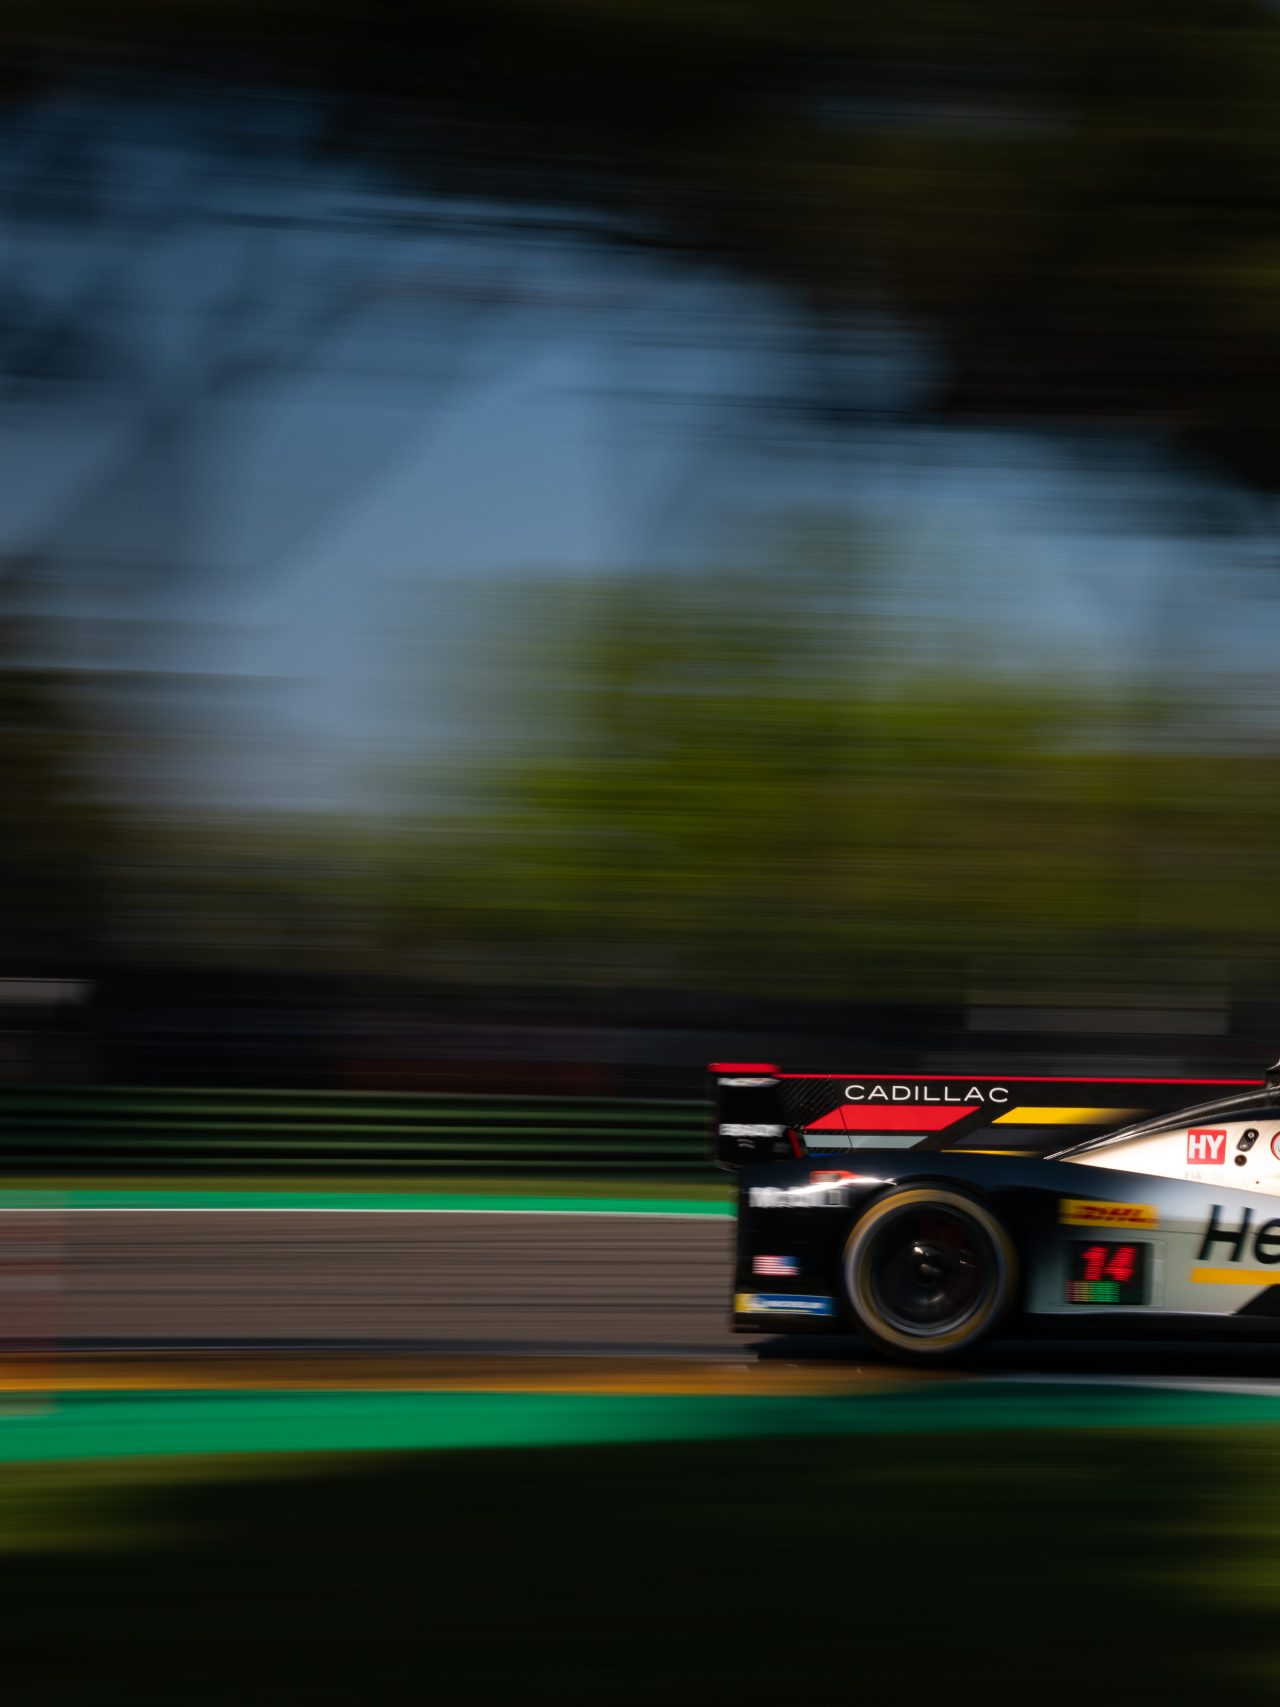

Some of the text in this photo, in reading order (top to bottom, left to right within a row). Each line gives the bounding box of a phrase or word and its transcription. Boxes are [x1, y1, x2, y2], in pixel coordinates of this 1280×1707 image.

[844, 1084, 1009, 1103] CADILLAC
[1188, 1134, 1225, 1160] HY
[1081, 1246, 1136, 1282] 14
